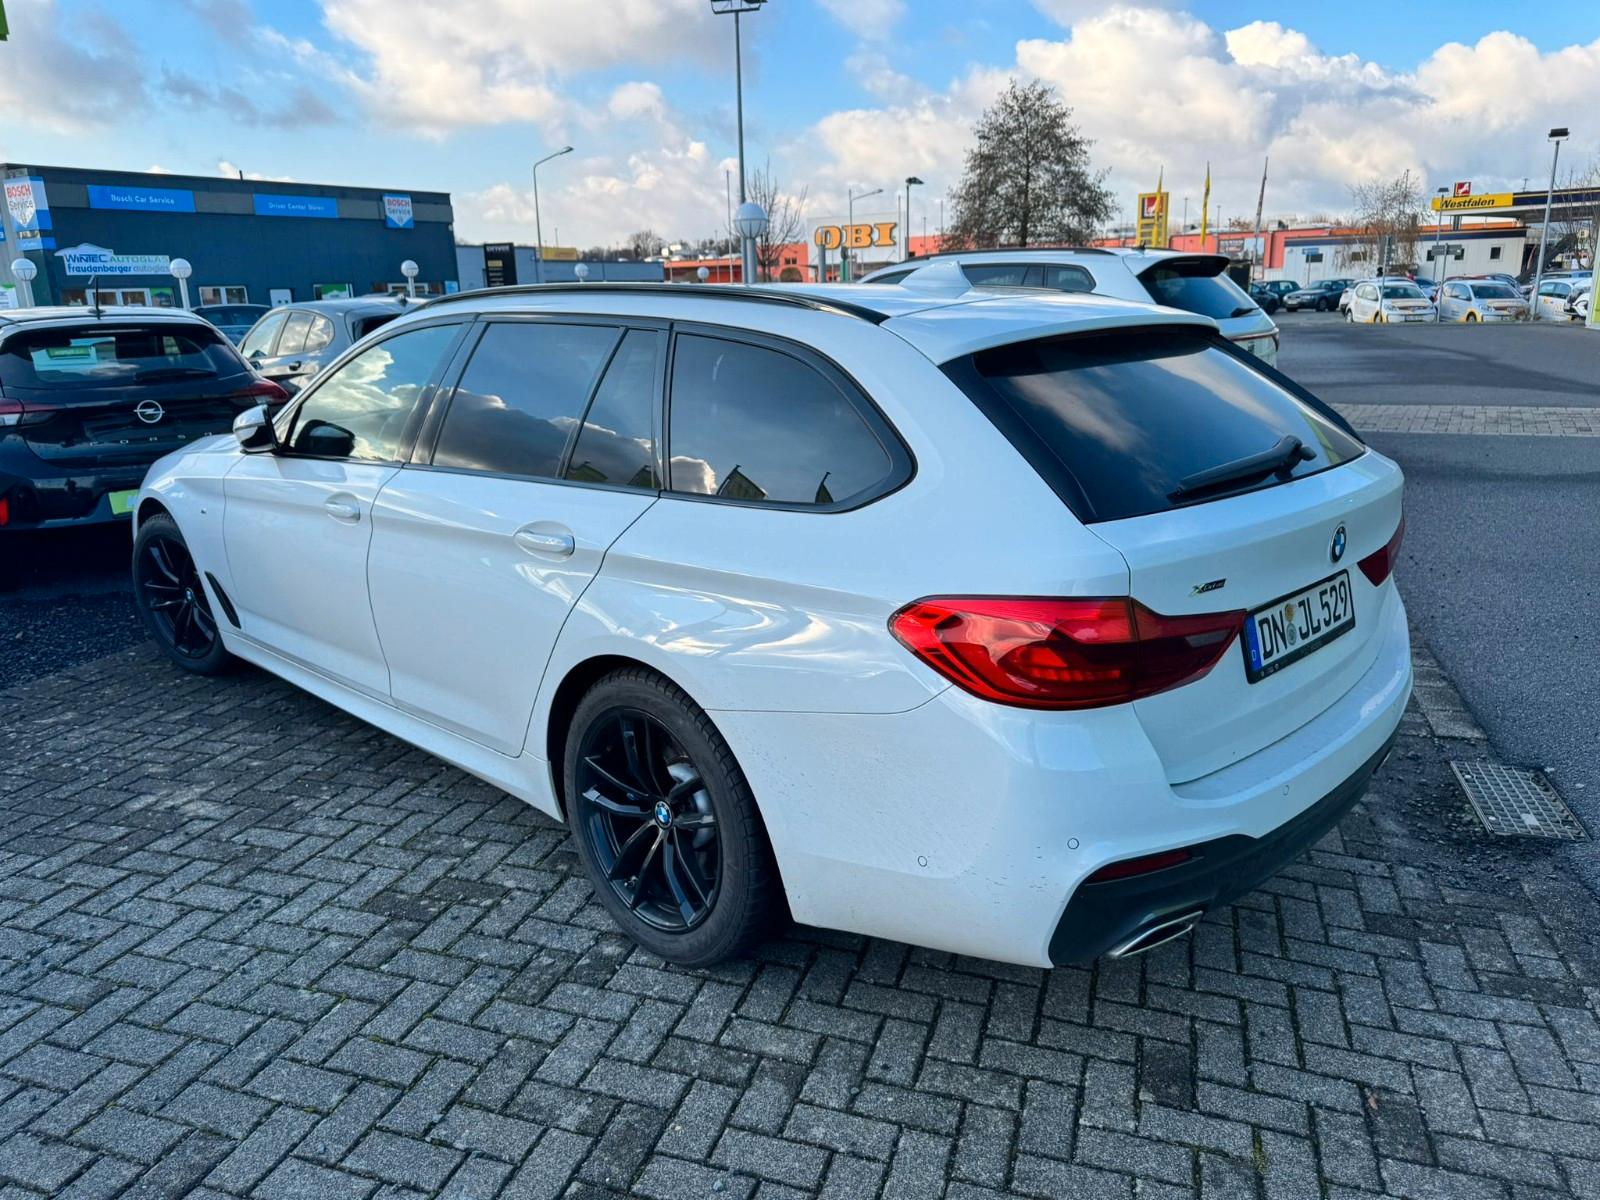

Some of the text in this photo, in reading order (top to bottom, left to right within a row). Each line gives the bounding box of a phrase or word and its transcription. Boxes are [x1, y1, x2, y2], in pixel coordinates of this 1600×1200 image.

[6, 183, 32, 199] BOSCH
[110, 193, 175, 206] Bosch Car Service
[386, 198, 411, 207] BOSCH
[1441, 198, 1495, 208] Westfalen
[8, 200, 34, 212] Service
[386, 207, 411, 216] Service
[815, 223, 897, 250] OBI
[1258, 609, 1288, 660] DN
